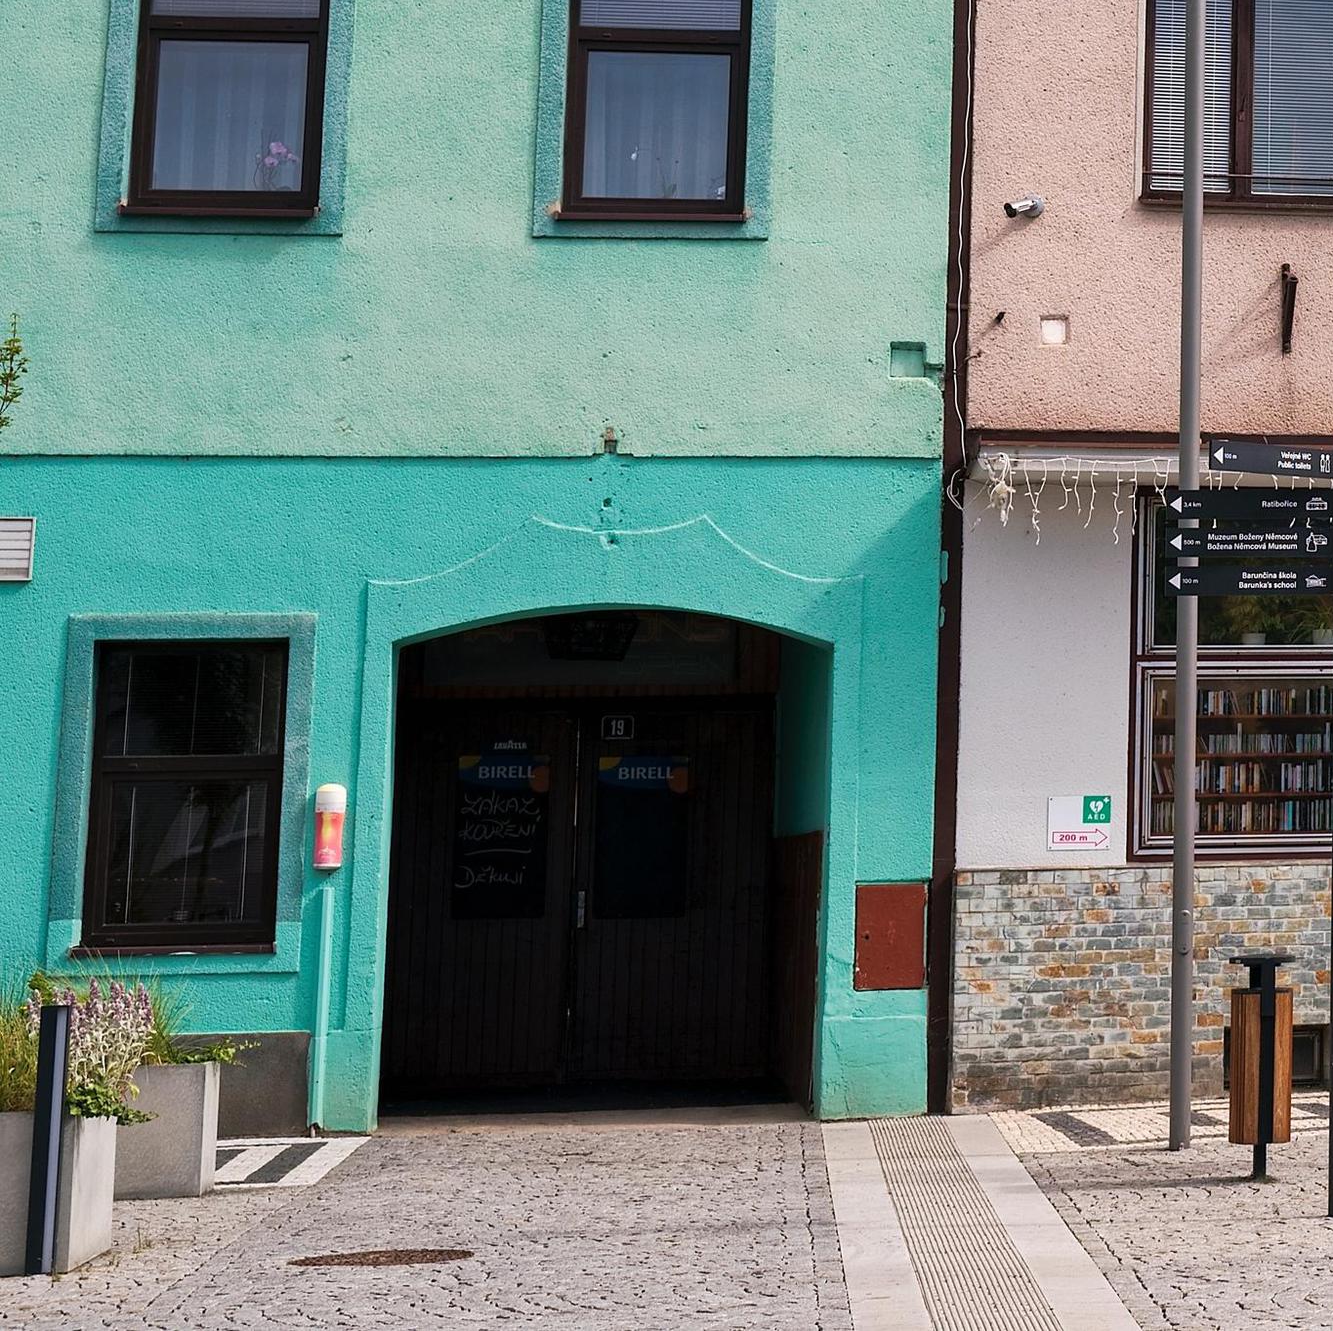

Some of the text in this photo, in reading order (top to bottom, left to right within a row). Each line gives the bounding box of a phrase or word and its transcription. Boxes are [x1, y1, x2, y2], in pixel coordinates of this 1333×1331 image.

[1281, 451, 1300, 460] Veřejné
[1278, 460, 1311, 470] Public toilets
[1262, 500, 1297, 508] Ratibořice
[1208, 532, 1297, 542] Muzeum Boženy Němcové
[1234, 542, 1266, 550] Němcová
[1242, 571, 1297, 579] Barunčina škola
[1239, 581, 1297, 589] Barunka's school
[611, 719, 624, 736] 19
[478, 765, 535, 779] BIRELL
[618, 766, 674, 779] BIRELL
[460, 789, 540, 815] ZÁKAZ
